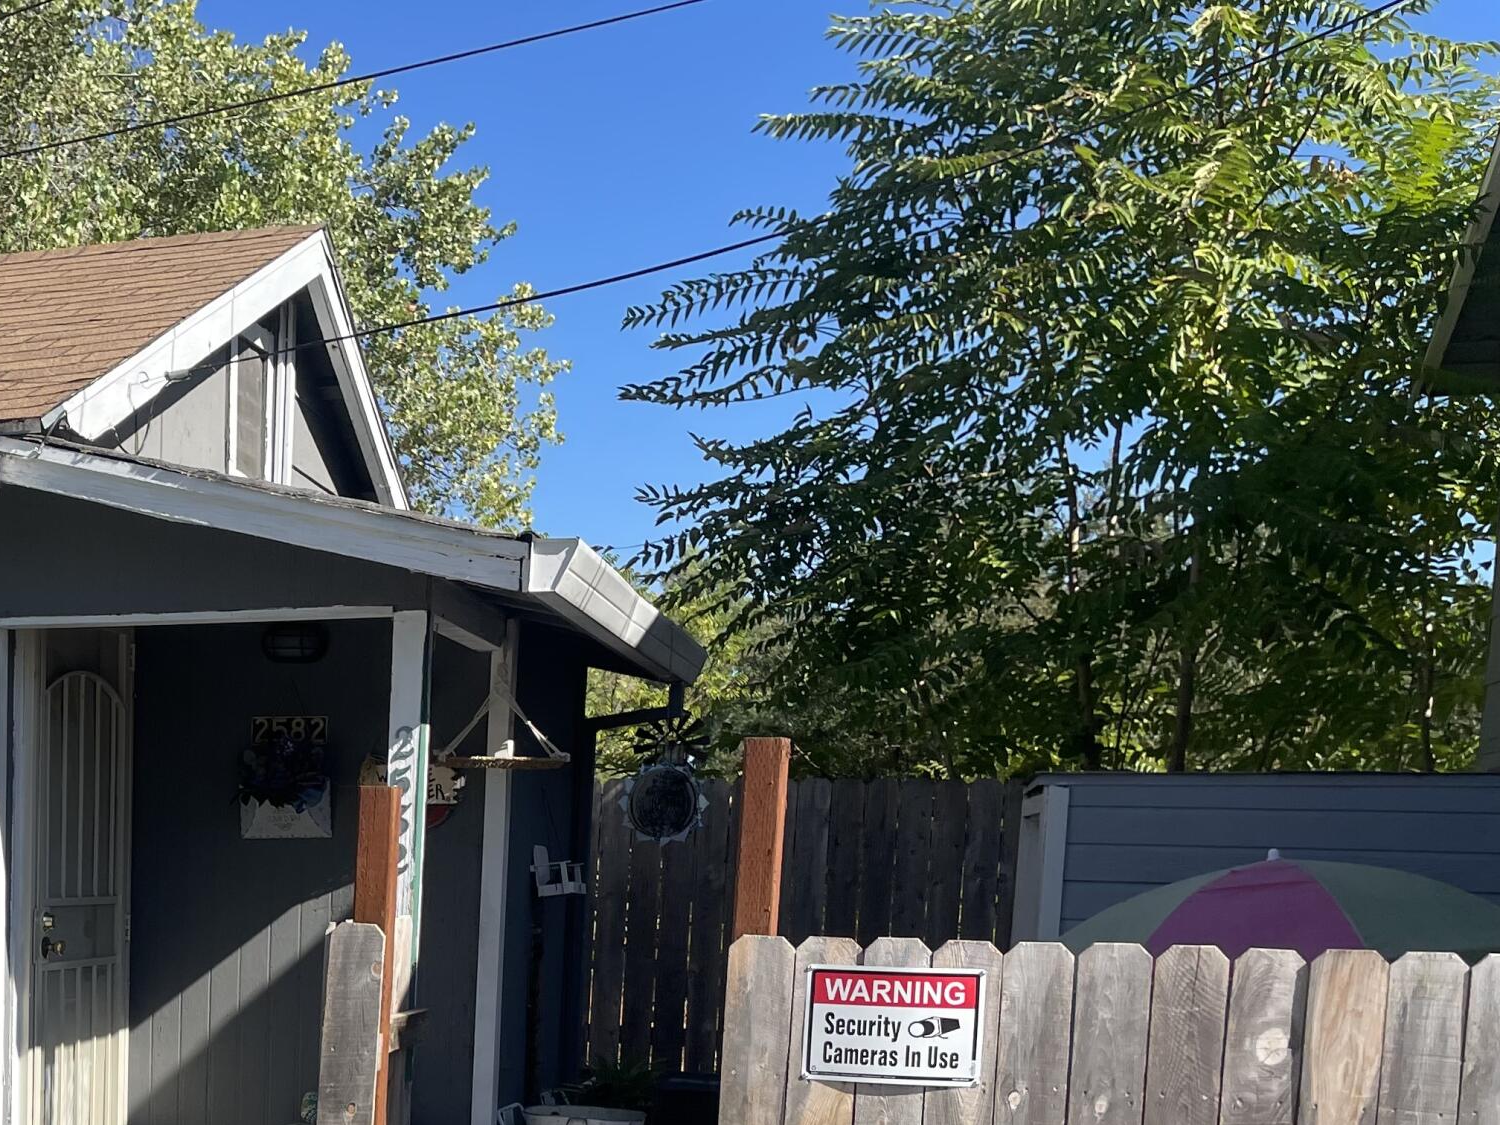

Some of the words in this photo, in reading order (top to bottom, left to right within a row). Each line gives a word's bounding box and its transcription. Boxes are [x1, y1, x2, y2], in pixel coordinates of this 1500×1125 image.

[255, 718, 325, 744] 2582
[824, 977, 966, 1006] WARNING
[824, 1011, 901, 1042] Security
[822, 1041, 898, 1067] Cameras
[905, 1045, 921, 1068] In
[928, 1046, 960, 1069] Use
